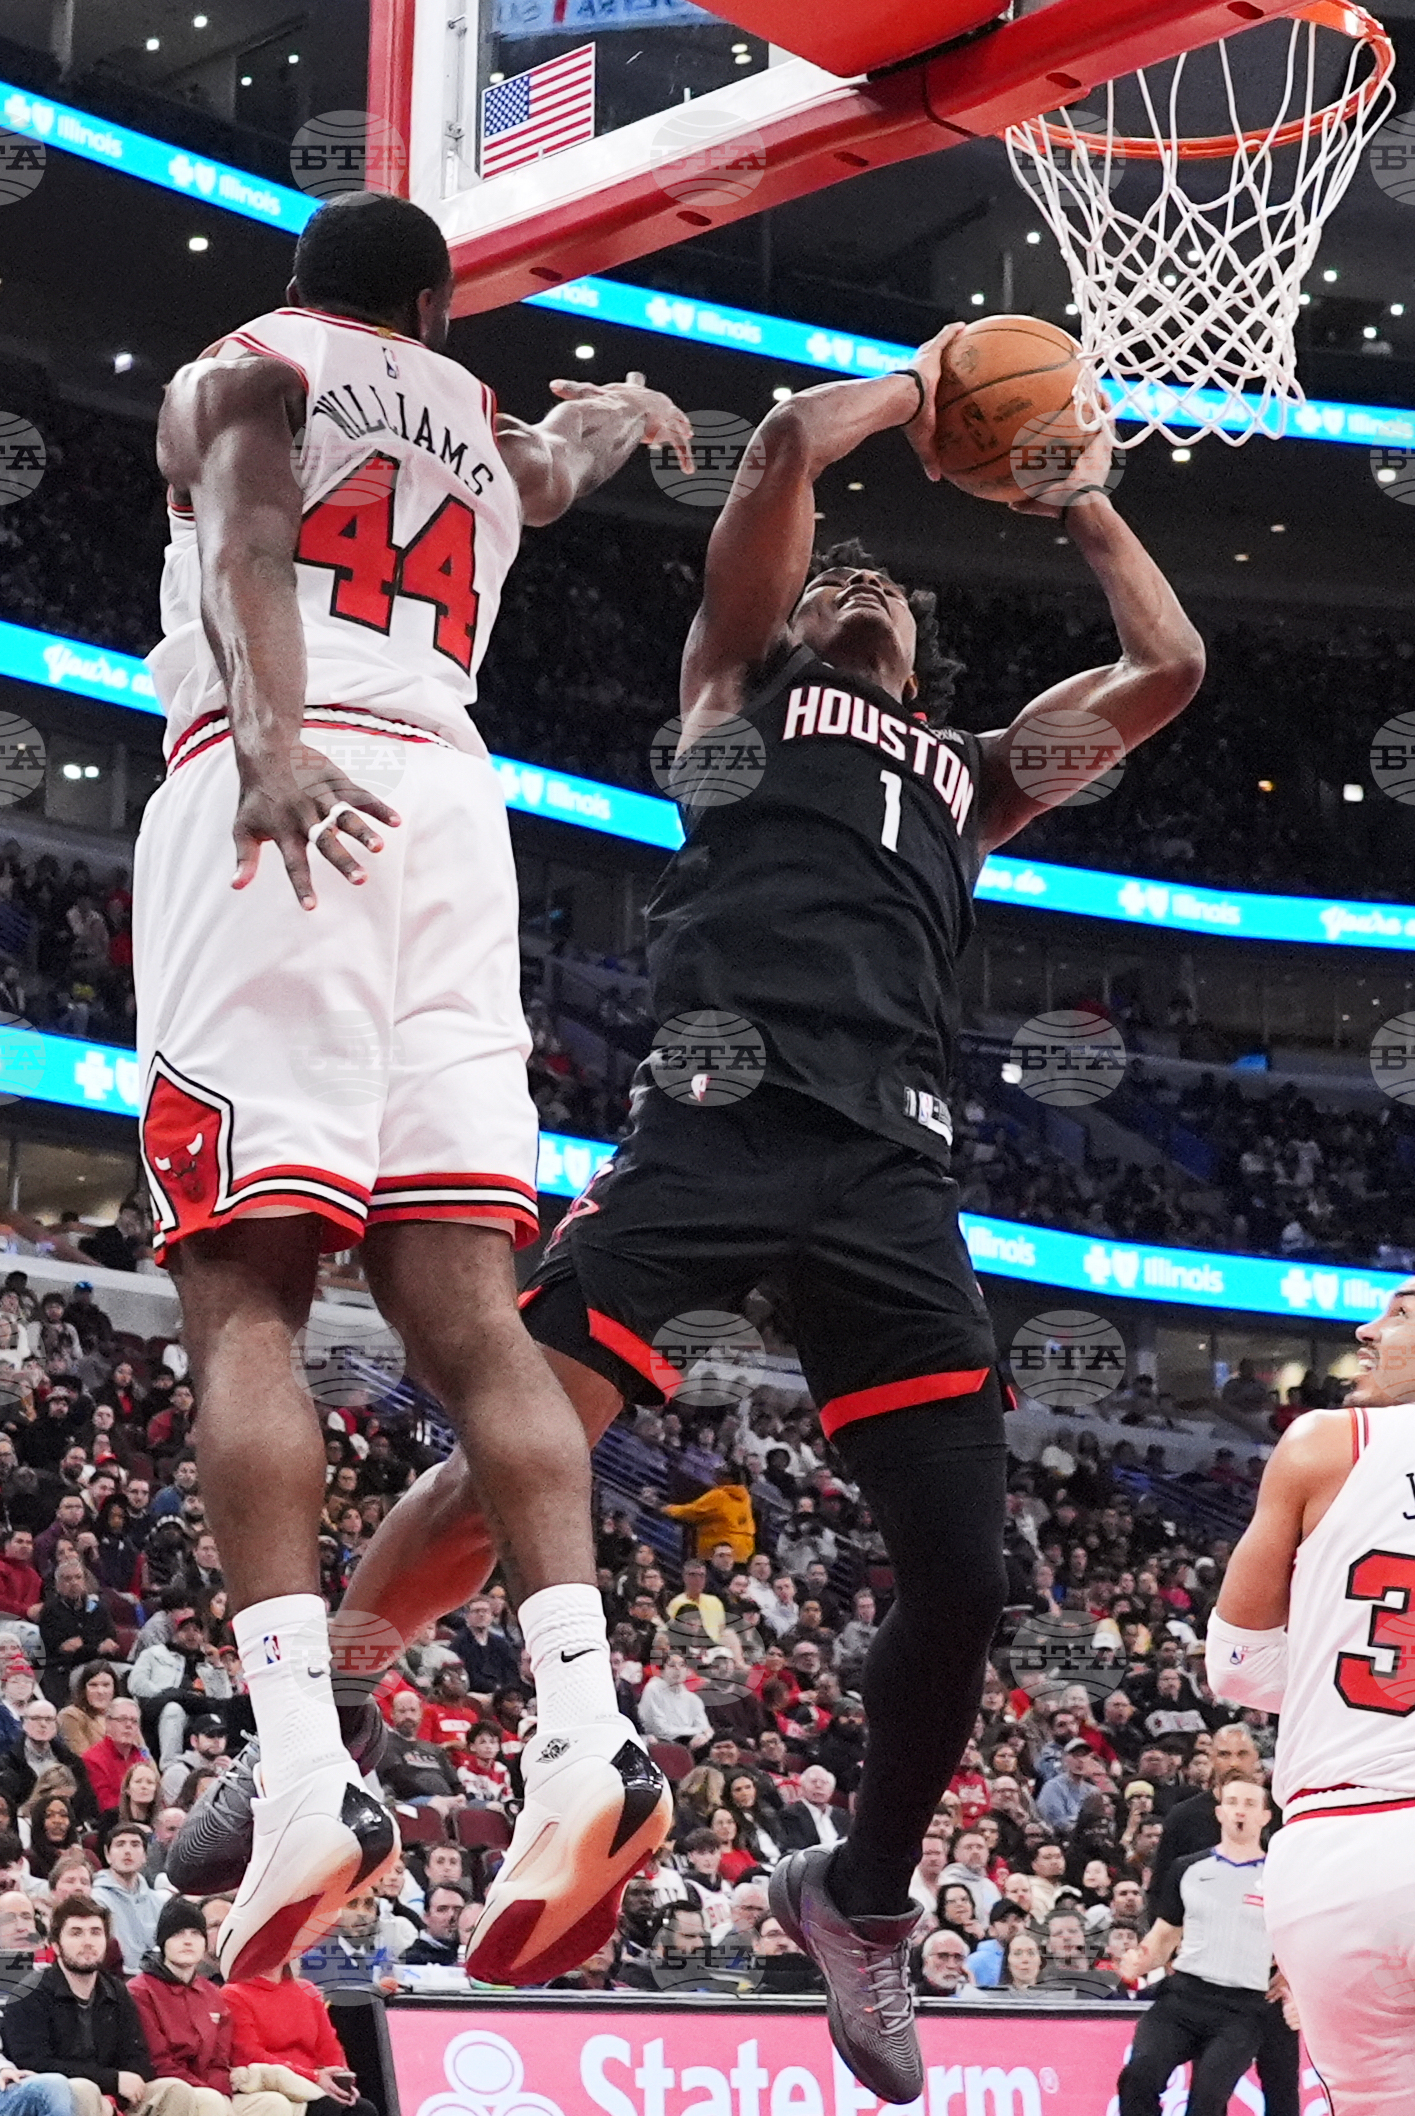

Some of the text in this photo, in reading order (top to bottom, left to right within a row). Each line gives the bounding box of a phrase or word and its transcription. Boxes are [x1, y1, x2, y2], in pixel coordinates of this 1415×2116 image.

[312, 385, 494, 496] WILLIAMS
[293, 449, 480, 678] 44
[783, 686, 974, 837] HOUSTON
[880, 769, 902, 853] 1
[1144, 1257, 1224, 1293] Illinois
[580, 2034, 824, 2116] State
